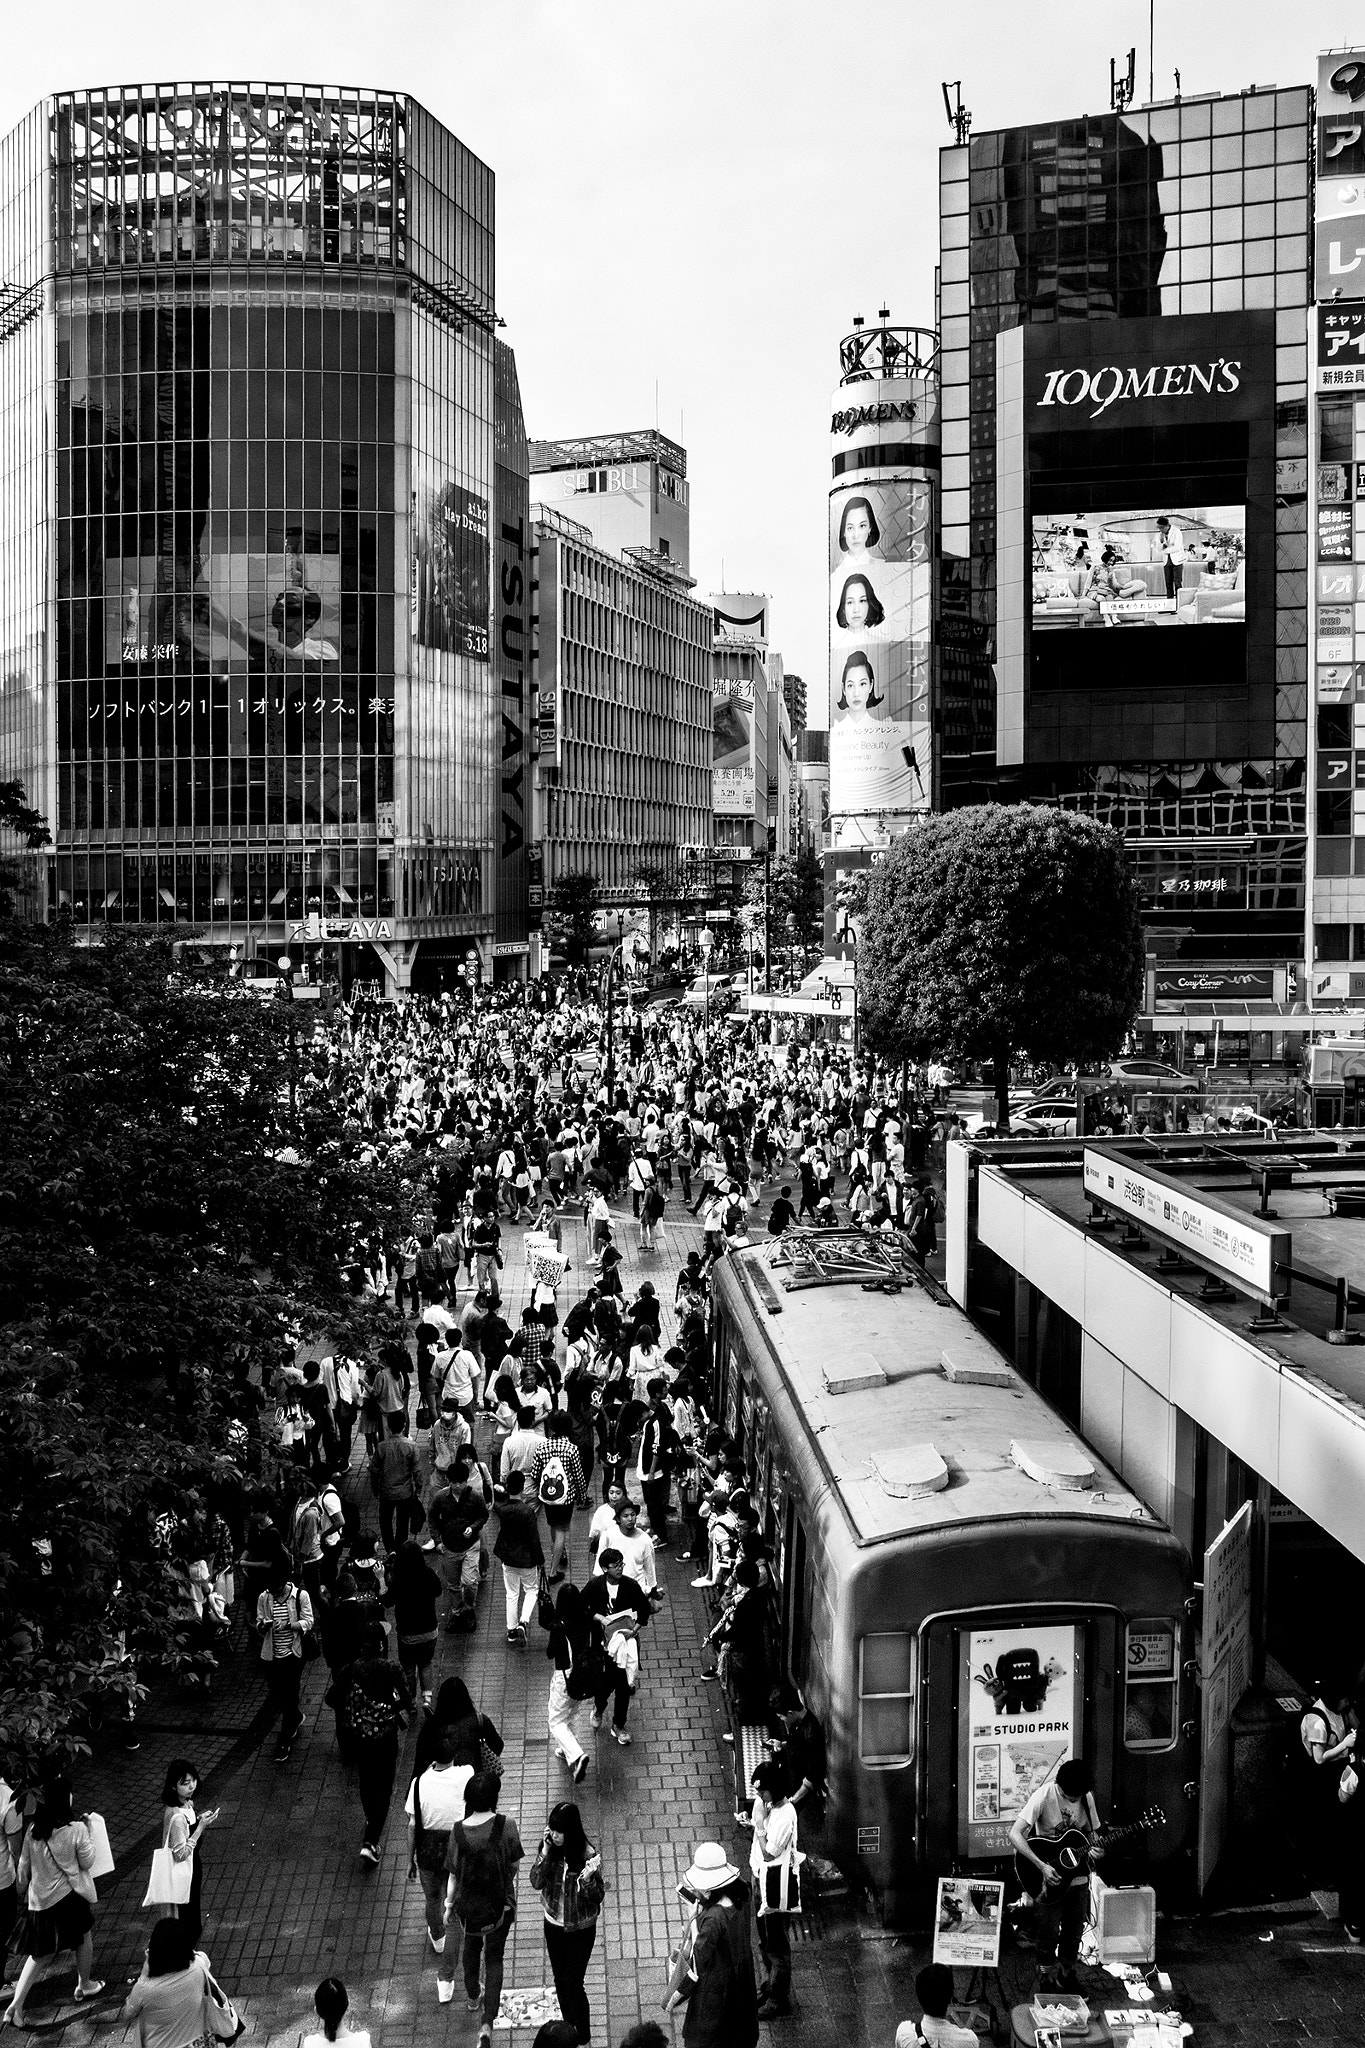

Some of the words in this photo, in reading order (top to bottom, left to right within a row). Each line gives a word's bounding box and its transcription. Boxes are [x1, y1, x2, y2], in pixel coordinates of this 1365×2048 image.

[1329, 241, 1365, 275] レ
[1325, 314, 1365, 327] キャッ
[1322, 369, 1365, 385] 新規会員
[563, 467, 639, 497] SEIBU
[659, 470, 688, 506] SEIBU
[444, 505, 461, 528] May
[462, 513, 488, 538] Dream
[468, 501, 487, 522] aiko
[466, 633, 488, 654] 5.18
[1328, 649, 1342, 660] 6F
[502, 515, 524, 860] TSUTAYA
[860, 740, 890, 751] Beauty
[433, 866, 480, 882] TSUTAYA
[994, 1724, 1036, 1735] STUDIO
[1038, 1721, 1069, 1732] PARK
